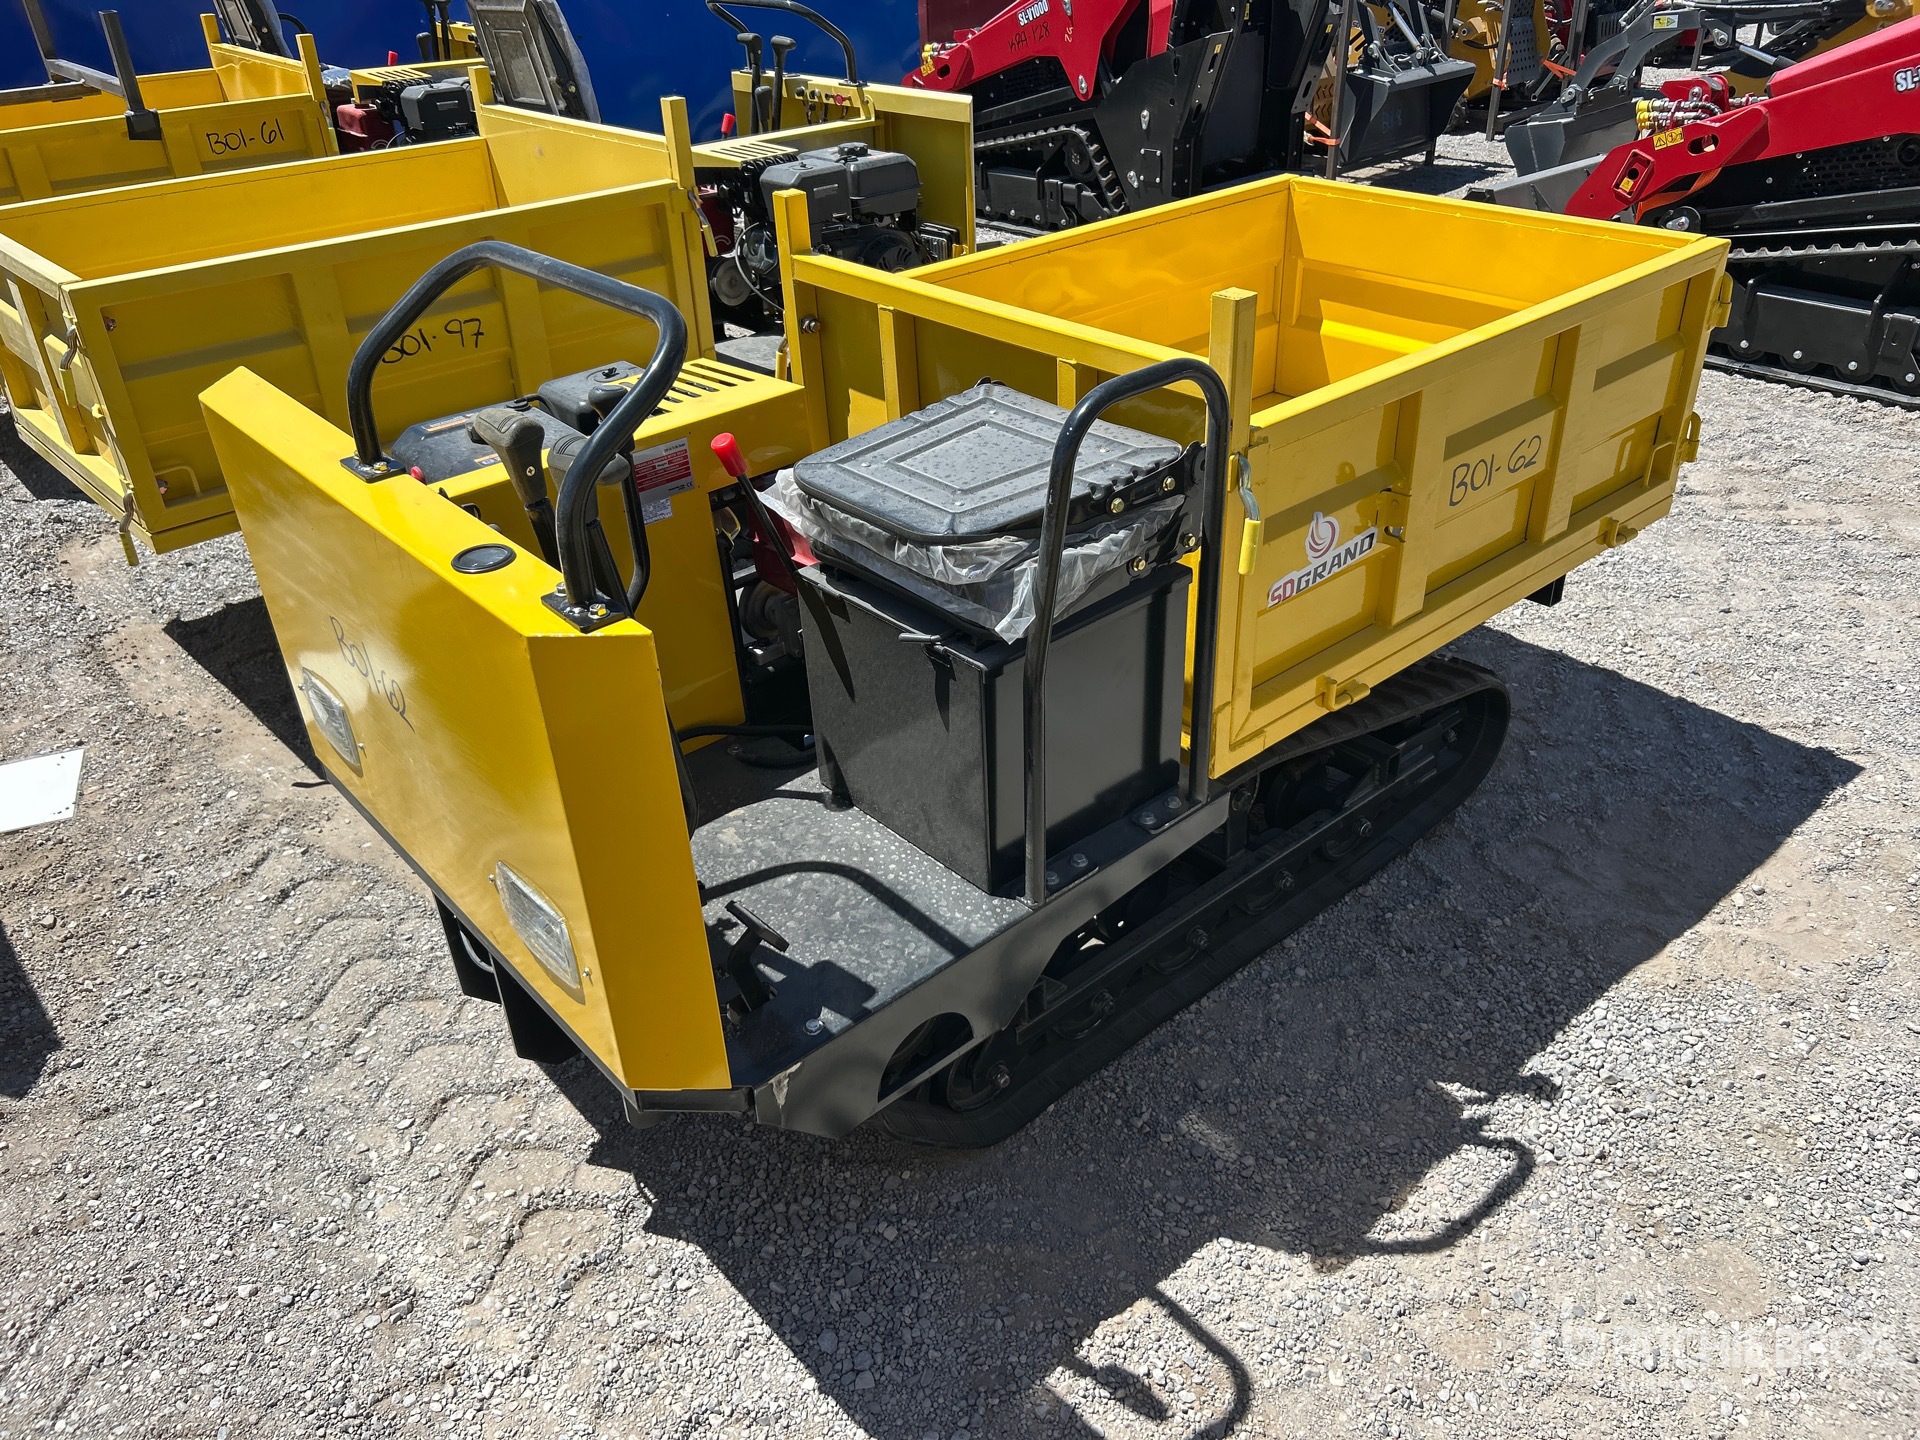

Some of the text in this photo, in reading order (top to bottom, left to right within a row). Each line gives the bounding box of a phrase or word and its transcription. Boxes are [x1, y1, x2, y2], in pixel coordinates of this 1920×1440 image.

[1018, 0, 1049, 26] SL-V1000
[1895, 65, 1920, 92] SL-
[1270, 532, 1376, 607] SDGRAND
